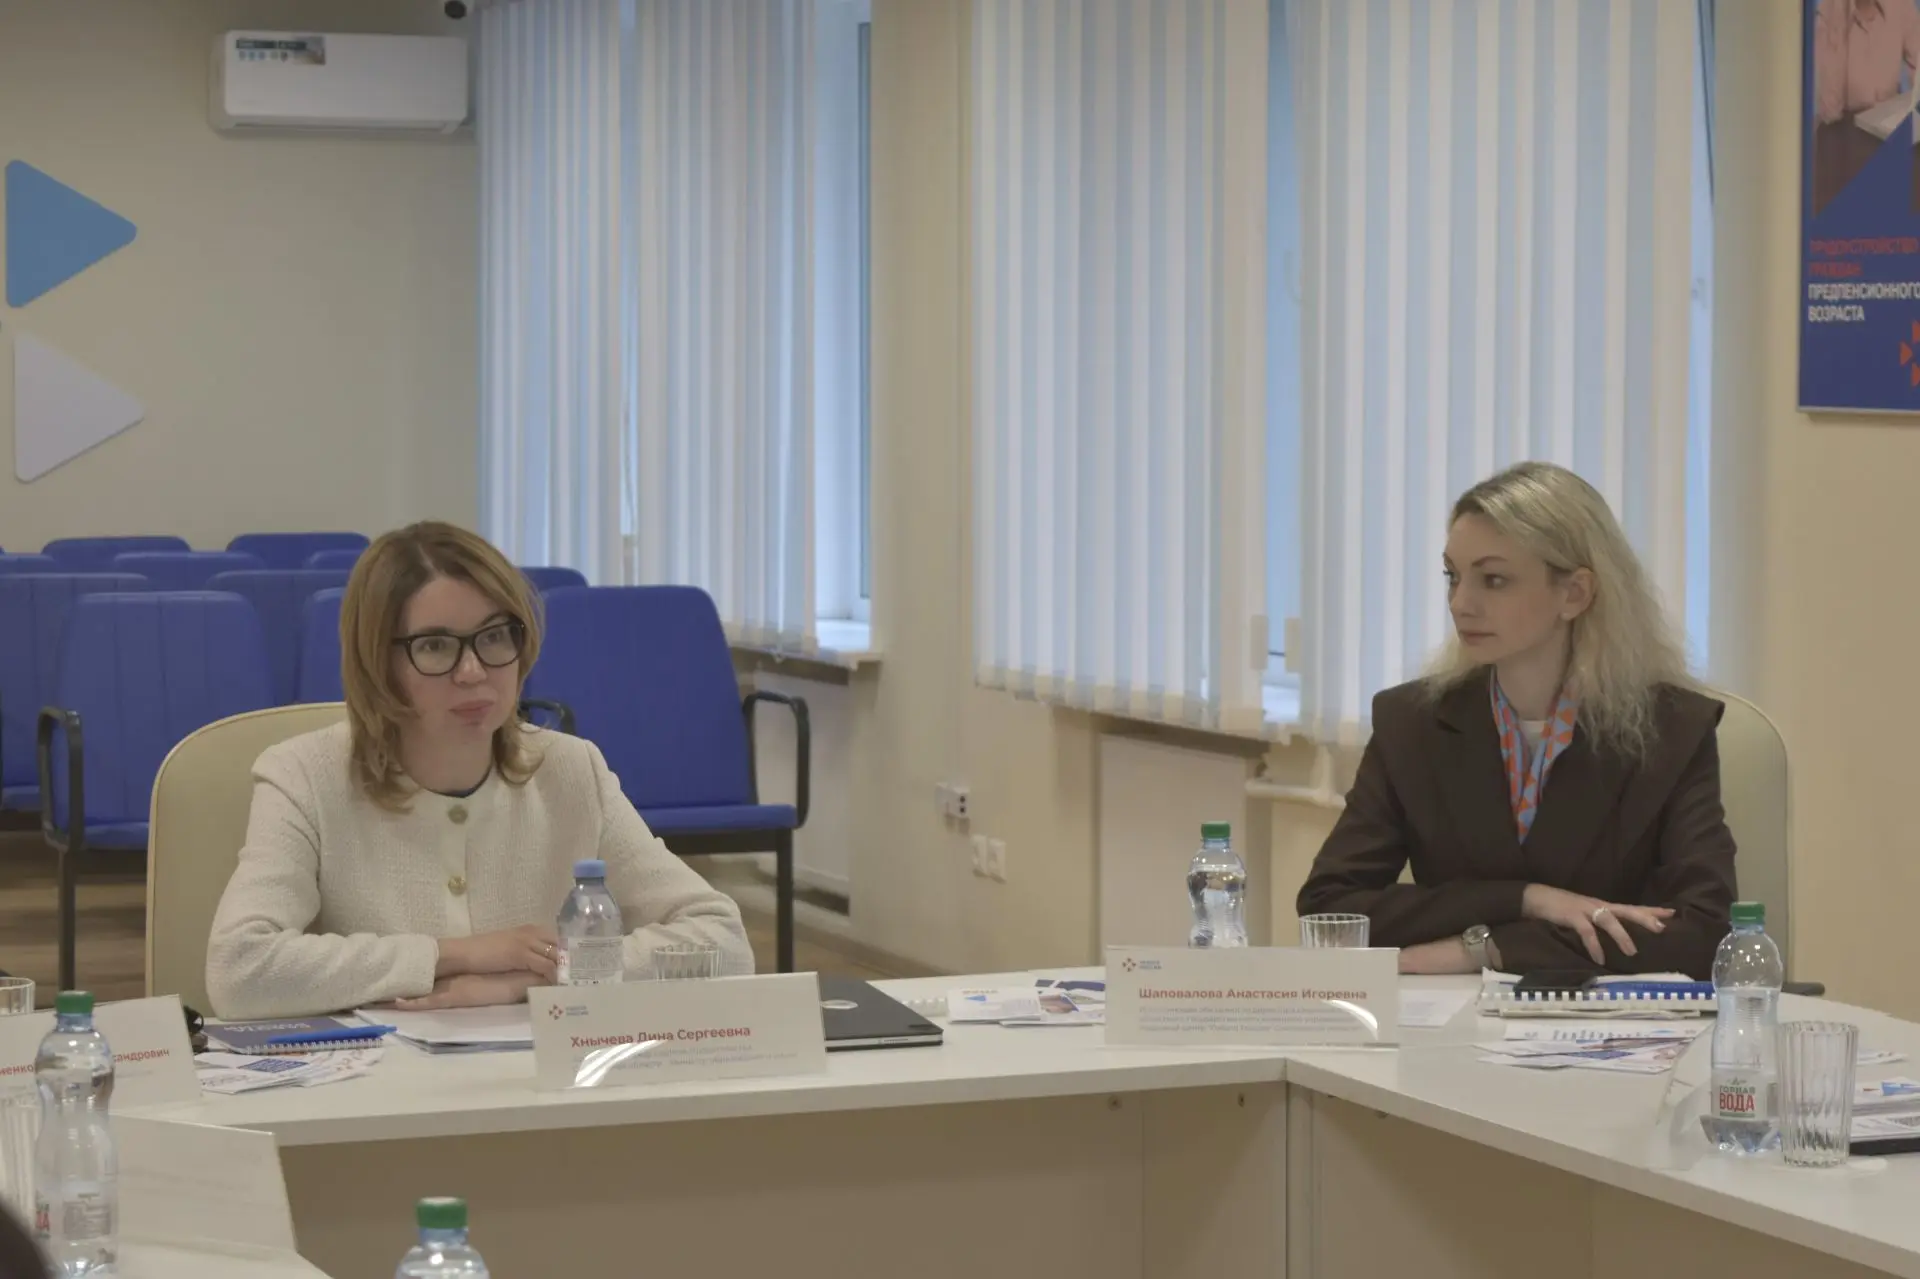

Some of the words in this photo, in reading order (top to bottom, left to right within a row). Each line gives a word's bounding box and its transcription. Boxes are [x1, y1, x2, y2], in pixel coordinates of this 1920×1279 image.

[1808, 282, 1920, 300] ПРЕДПЕНСИОННОГО
[1808, 305, 1865, 322] ВОЗРАСТА
[1139, 988, 1223, 999] Шаповалова
[1228, 988, 1298, 999] Анастасия
[1302, 988, 1368, 1000] Игоревна
[571, 1034, 634, 1047] Хнычева
[637, 1031, 675, 1044] Дина
[677, 1027, 752, 1042] Сергеевна
[1719, 1085, 1756, 1094] ГОРНАЯ
[1719, 1093, 1755, 1112] ВОДА
